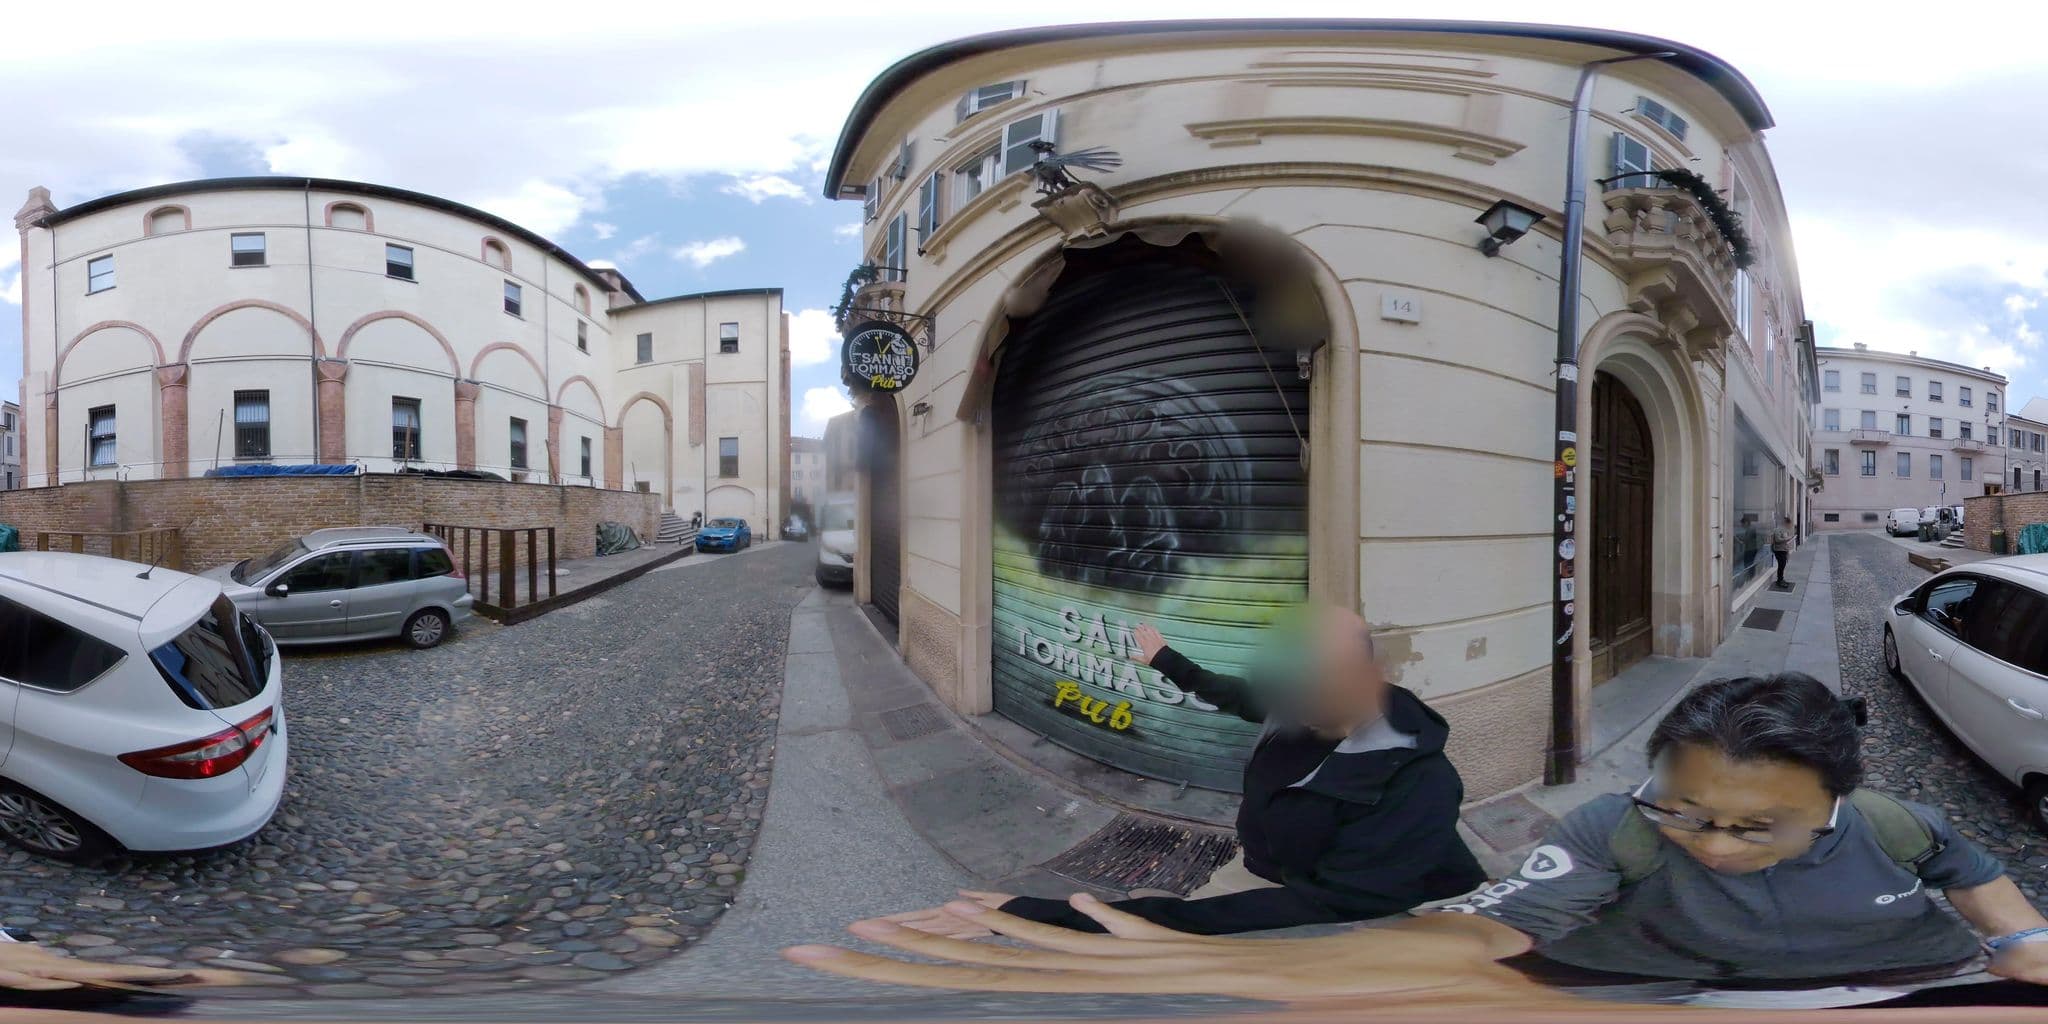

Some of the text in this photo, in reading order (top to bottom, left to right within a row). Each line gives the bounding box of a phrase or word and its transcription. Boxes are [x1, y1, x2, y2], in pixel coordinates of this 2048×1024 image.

[1393, 299, 1412, 313] 14
[861, 352, 892, 365] SAN
[849, 363, 914, 376] TOMMASO
[871, 374, 896, 389] Pub
[1055, 680, 1133, 731] Pub
